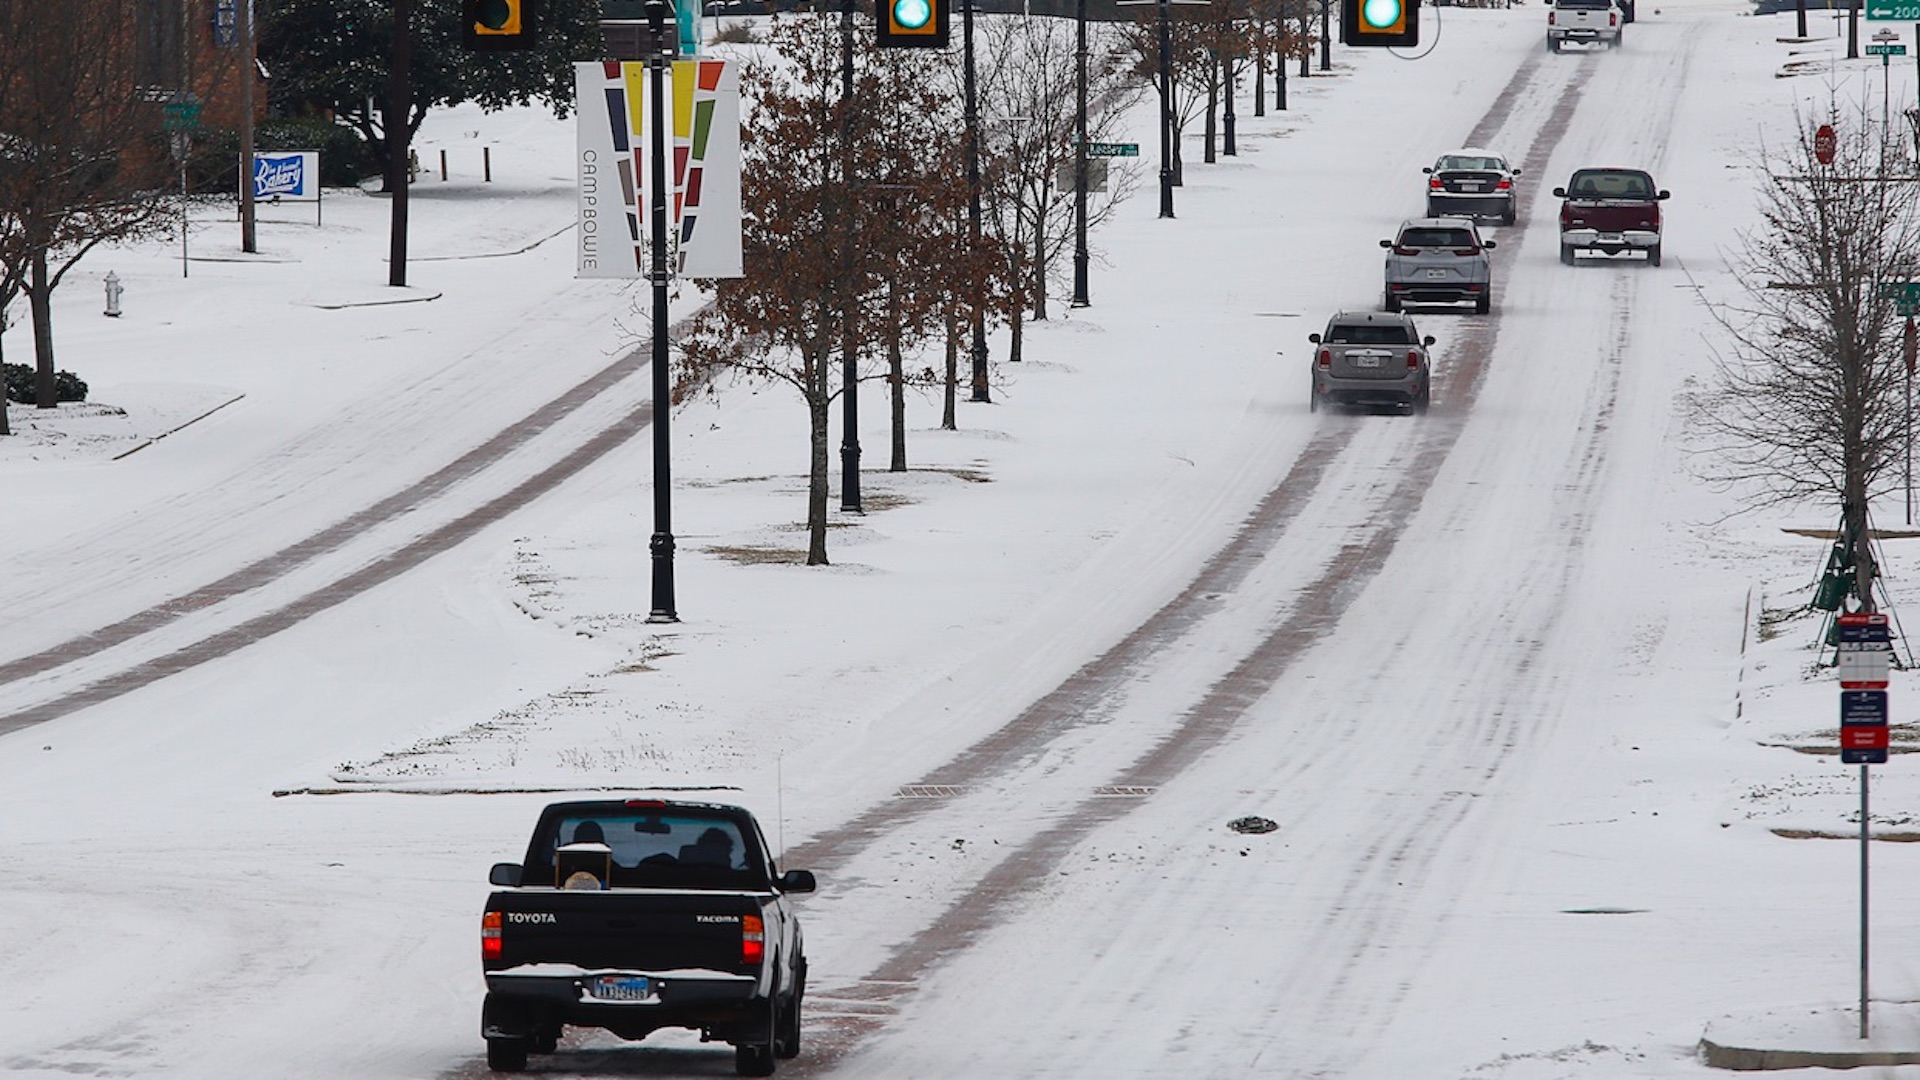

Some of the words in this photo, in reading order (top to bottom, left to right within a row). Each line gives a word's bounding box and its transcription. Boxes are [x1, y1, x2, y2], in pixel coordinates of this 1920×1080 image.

[254, 159, 301, 195] Bakery
[507, 912, 556, 924] TOYOTA
[695, 914, 739, 924] TACOMA
